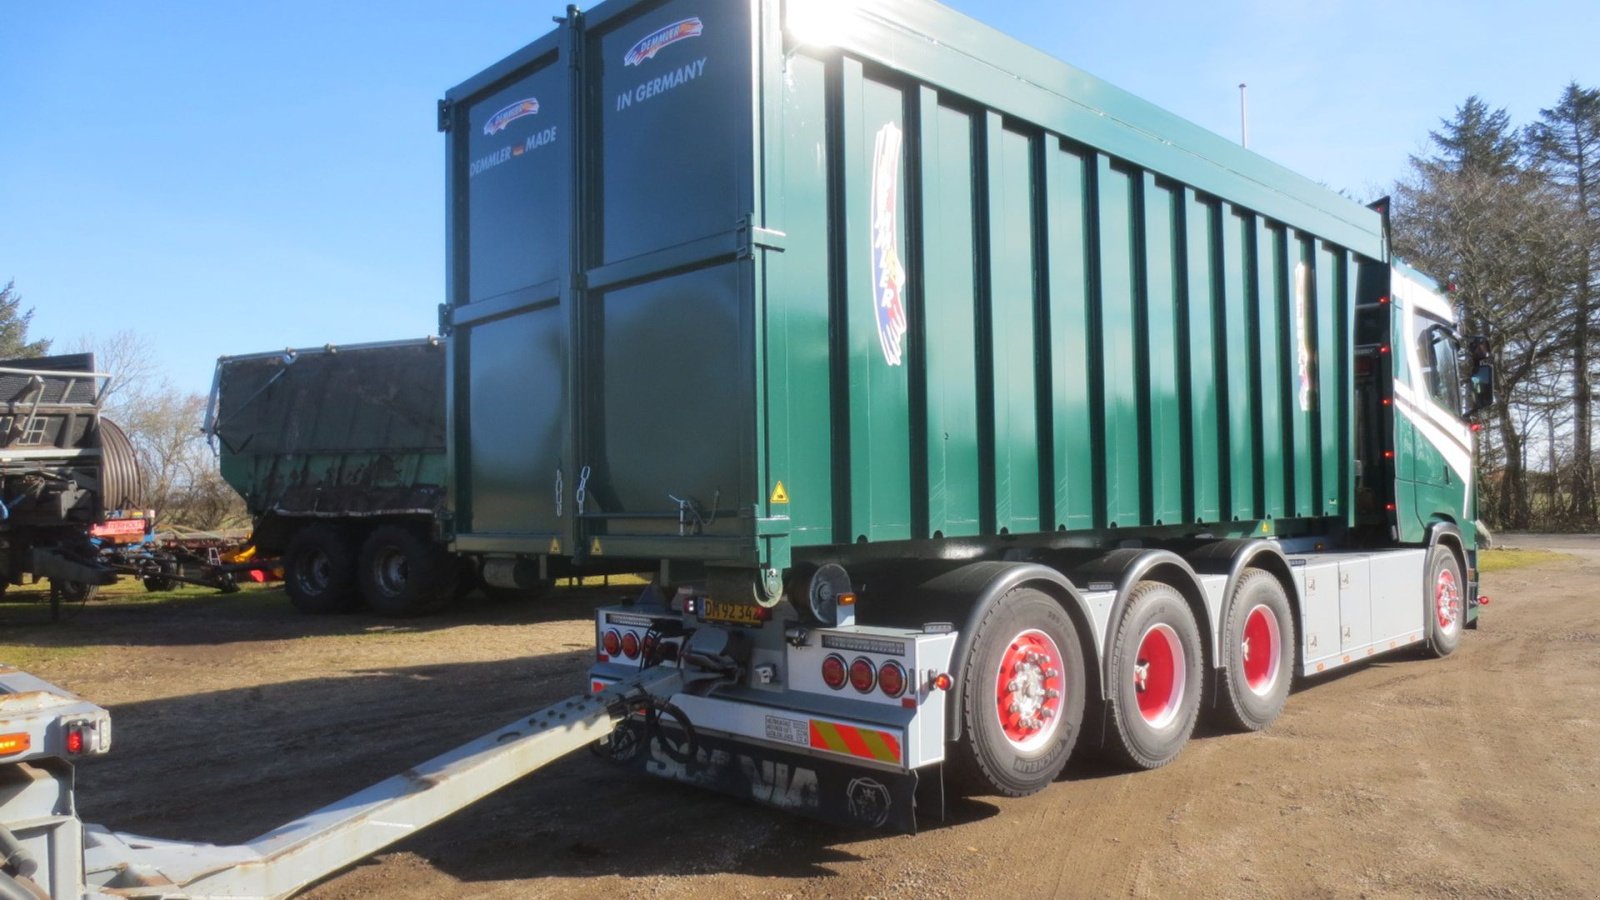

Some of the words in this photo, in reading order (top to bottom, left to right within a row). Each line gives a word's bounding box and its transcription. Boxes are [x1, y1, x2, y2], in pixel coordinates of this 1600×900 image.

[640, 25, 680, 53] DEMMLER
[616, 89, 632, 112] IN
[635, 56, 707, 103] GERMANY
[470, 145, 512, 177] DEMMLER
[524, 126, 557, 153] MADE
[722, 602, 736, 619] 92
